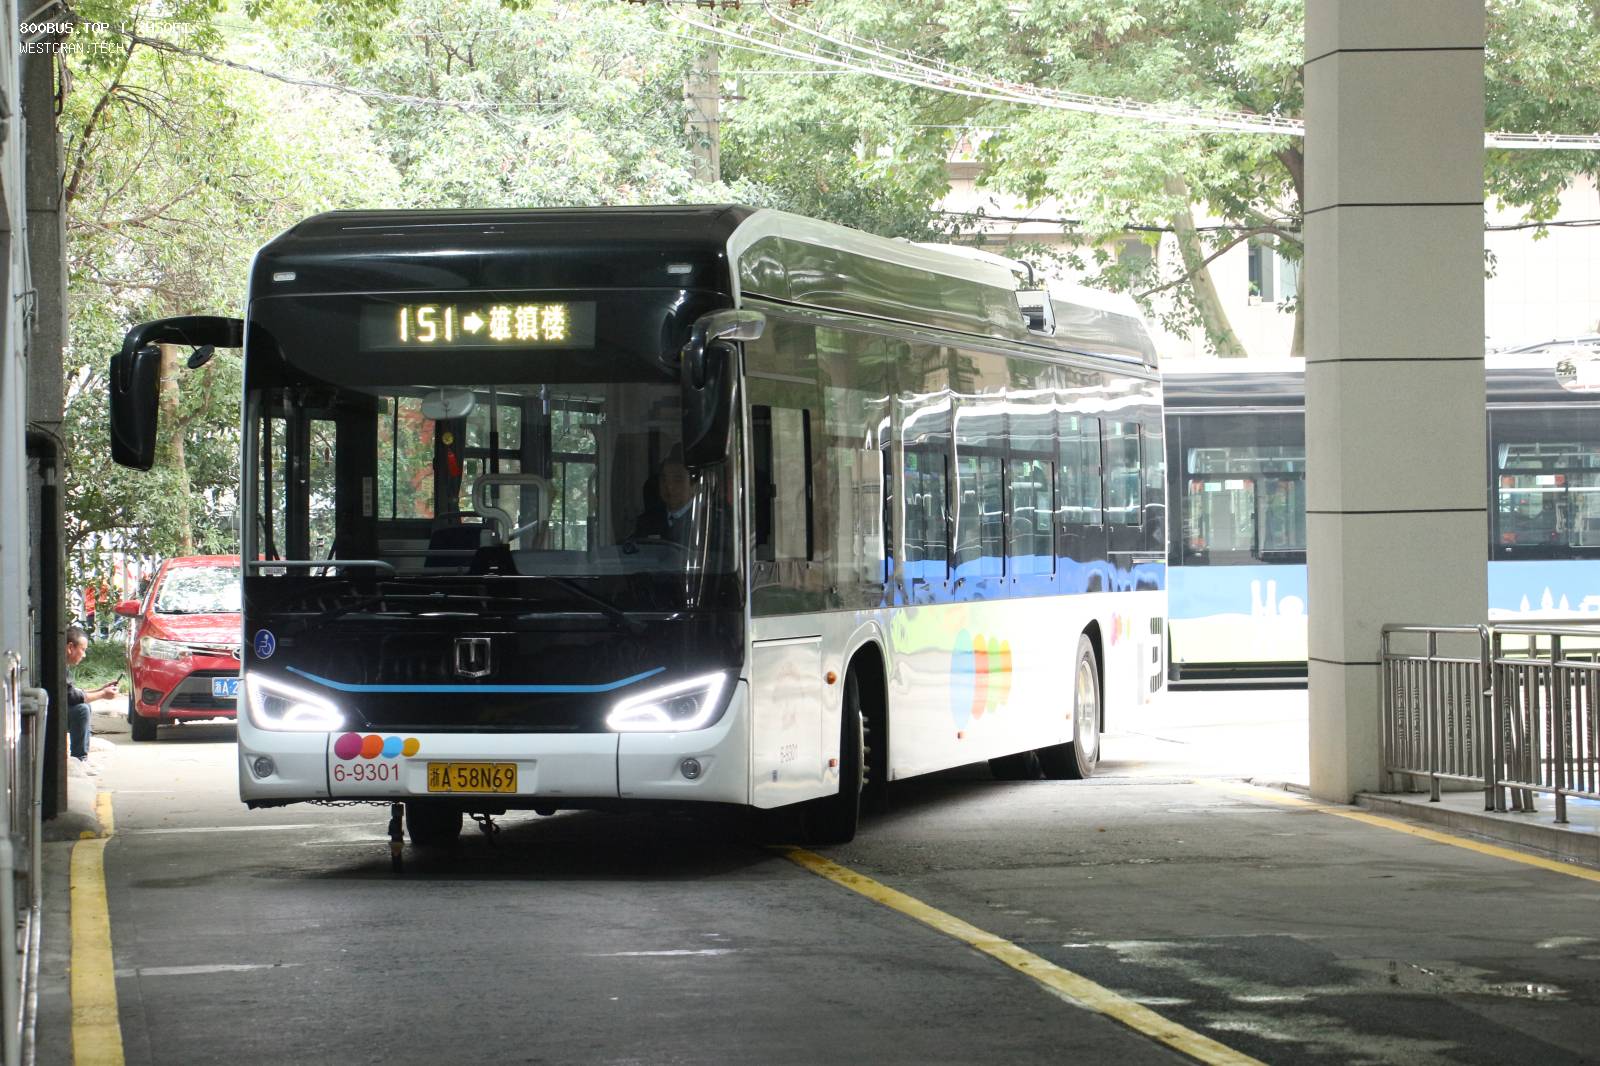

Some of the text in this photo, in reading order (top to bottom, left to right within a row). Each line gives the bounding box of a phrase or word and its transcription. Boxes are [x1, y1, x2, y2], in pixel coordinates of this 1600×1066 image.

[399, 306, 454, 342] 151
[489, 304, 567, 341] 雄镇楼
[334, 763, 399, 782] 6-9301
